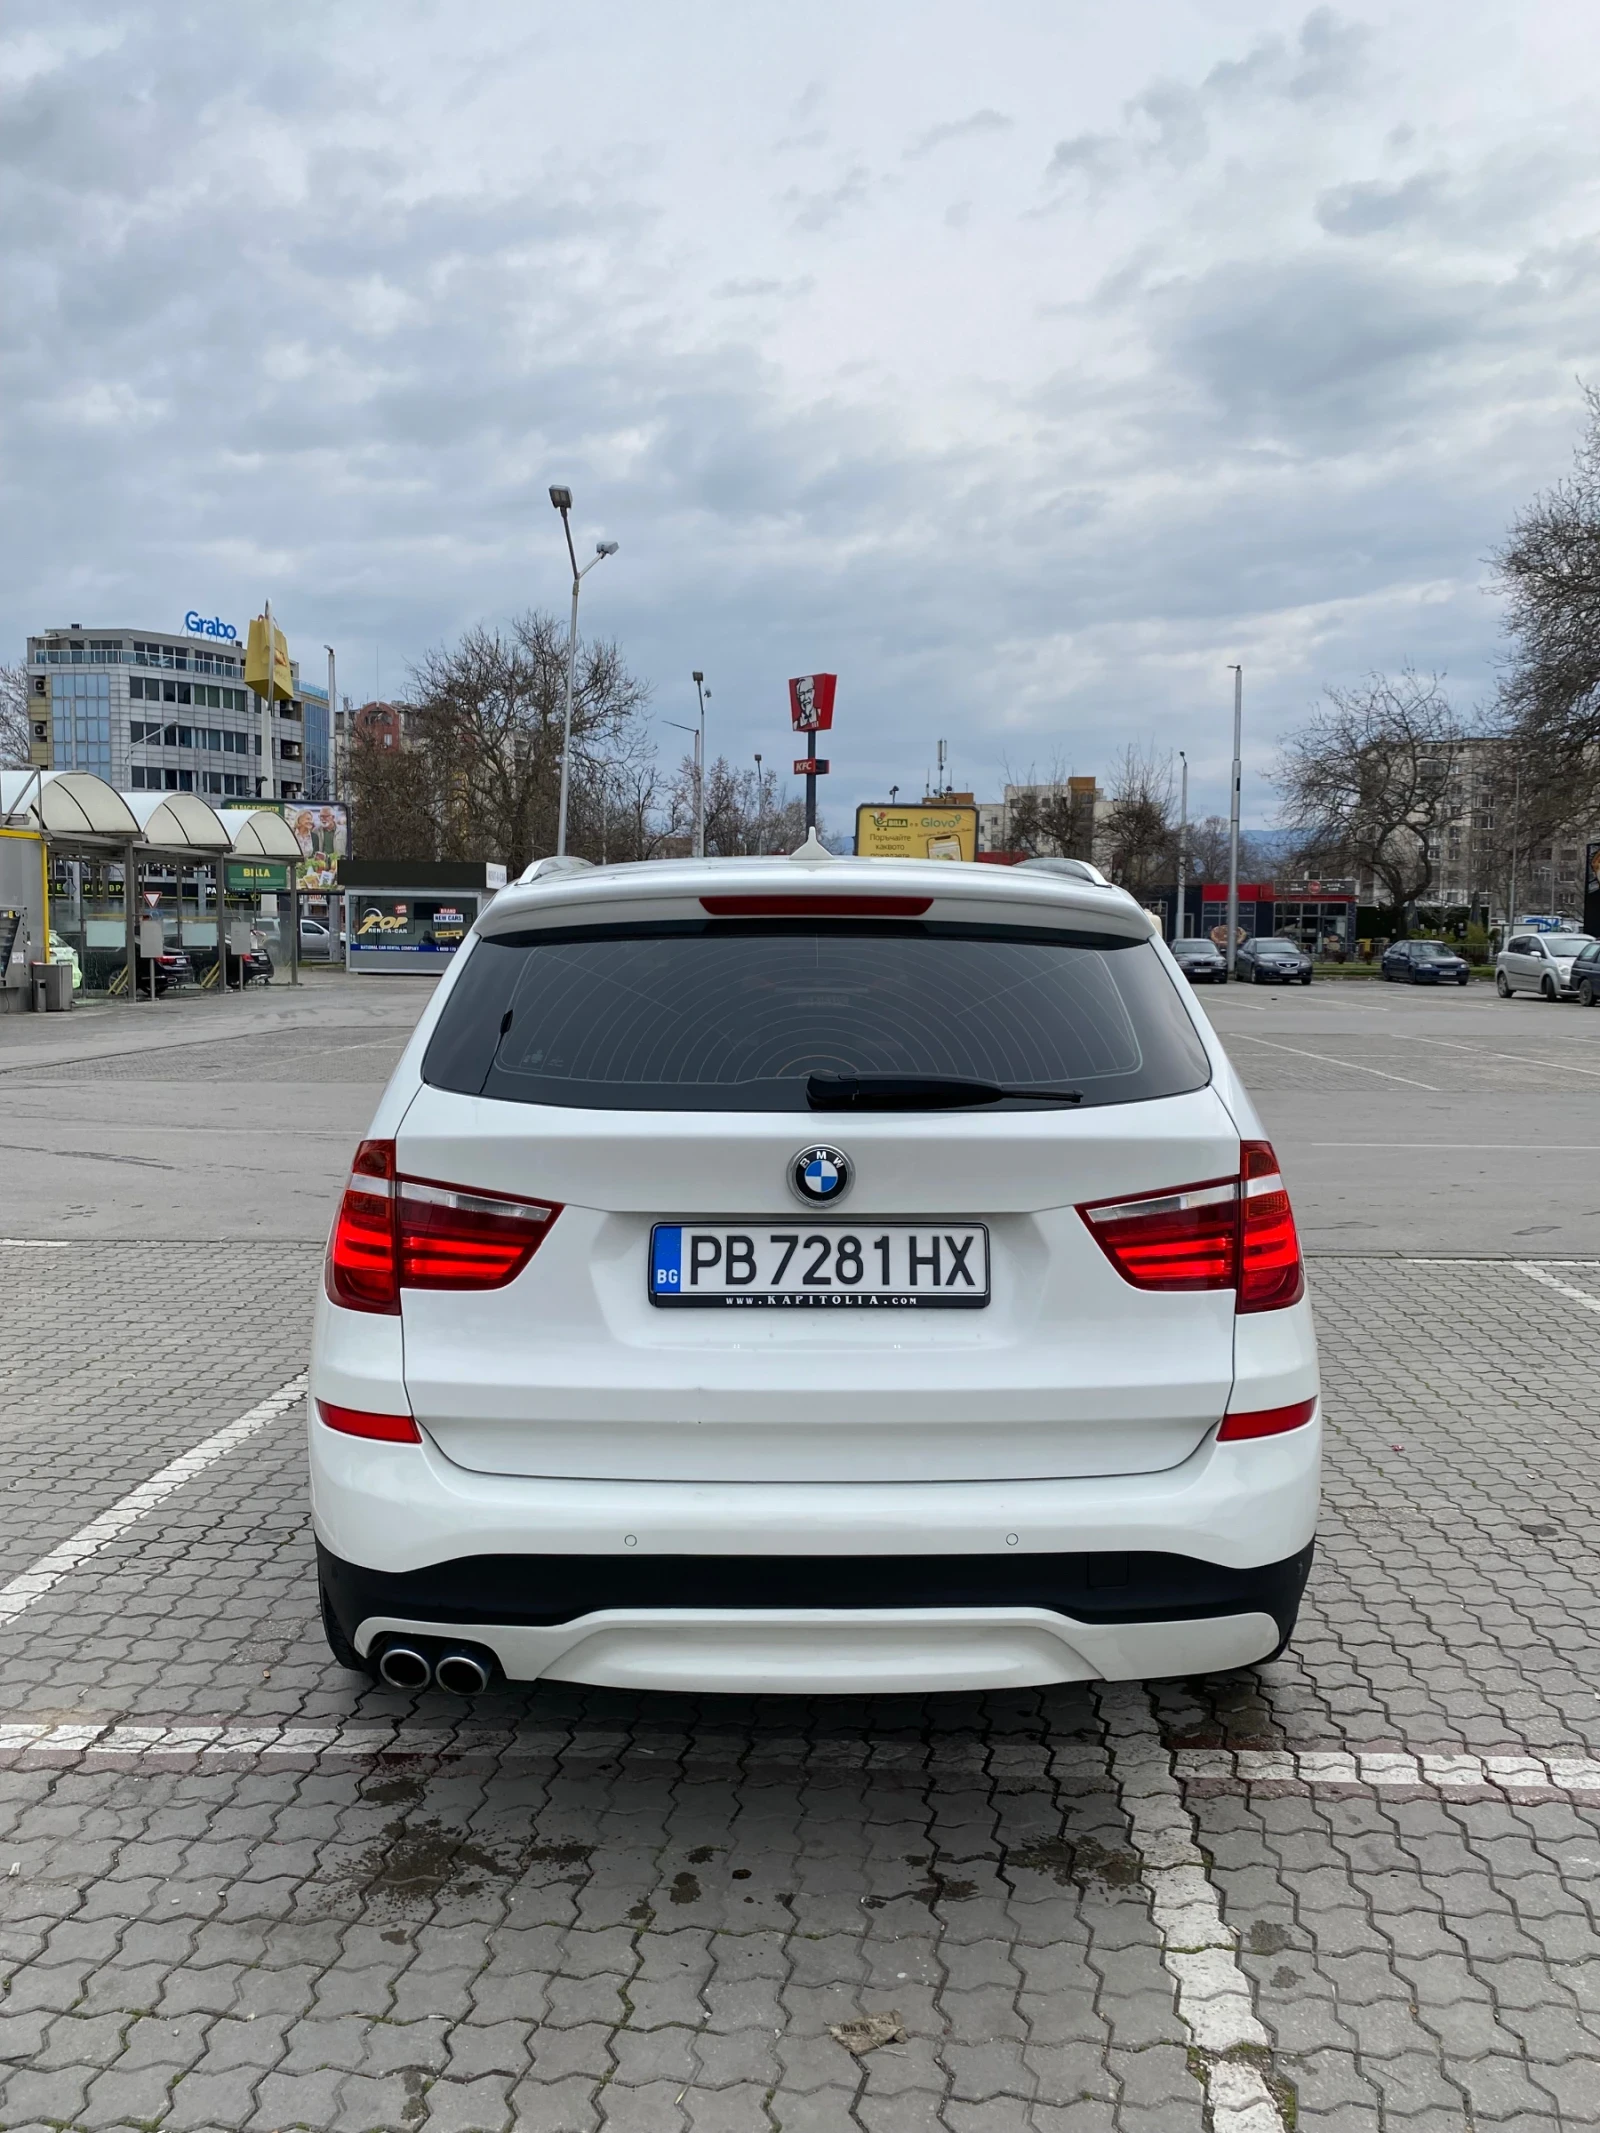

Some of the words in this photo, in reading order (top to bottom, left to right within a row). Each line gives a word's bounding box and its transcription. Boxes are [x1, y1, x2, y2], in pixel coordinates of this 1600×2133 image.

[185, 611, 237, 639] Grabo
[796, 762, 812, 771] KFC
[921, 817, 956, 828] Glovo
[870, 834, 911, 843] Поръчайте
[243, 868, 271, 877] BILLA
[357, 916, 408, 935] TOP
[799, 1151, 844, 1169] BMW
[690, 1235, 756, 1285] PB
[770, 1235, 890, 1286] 7281
[909, 1235, 975, 1286] HX
[657, 1269, 678, 1284] BG
